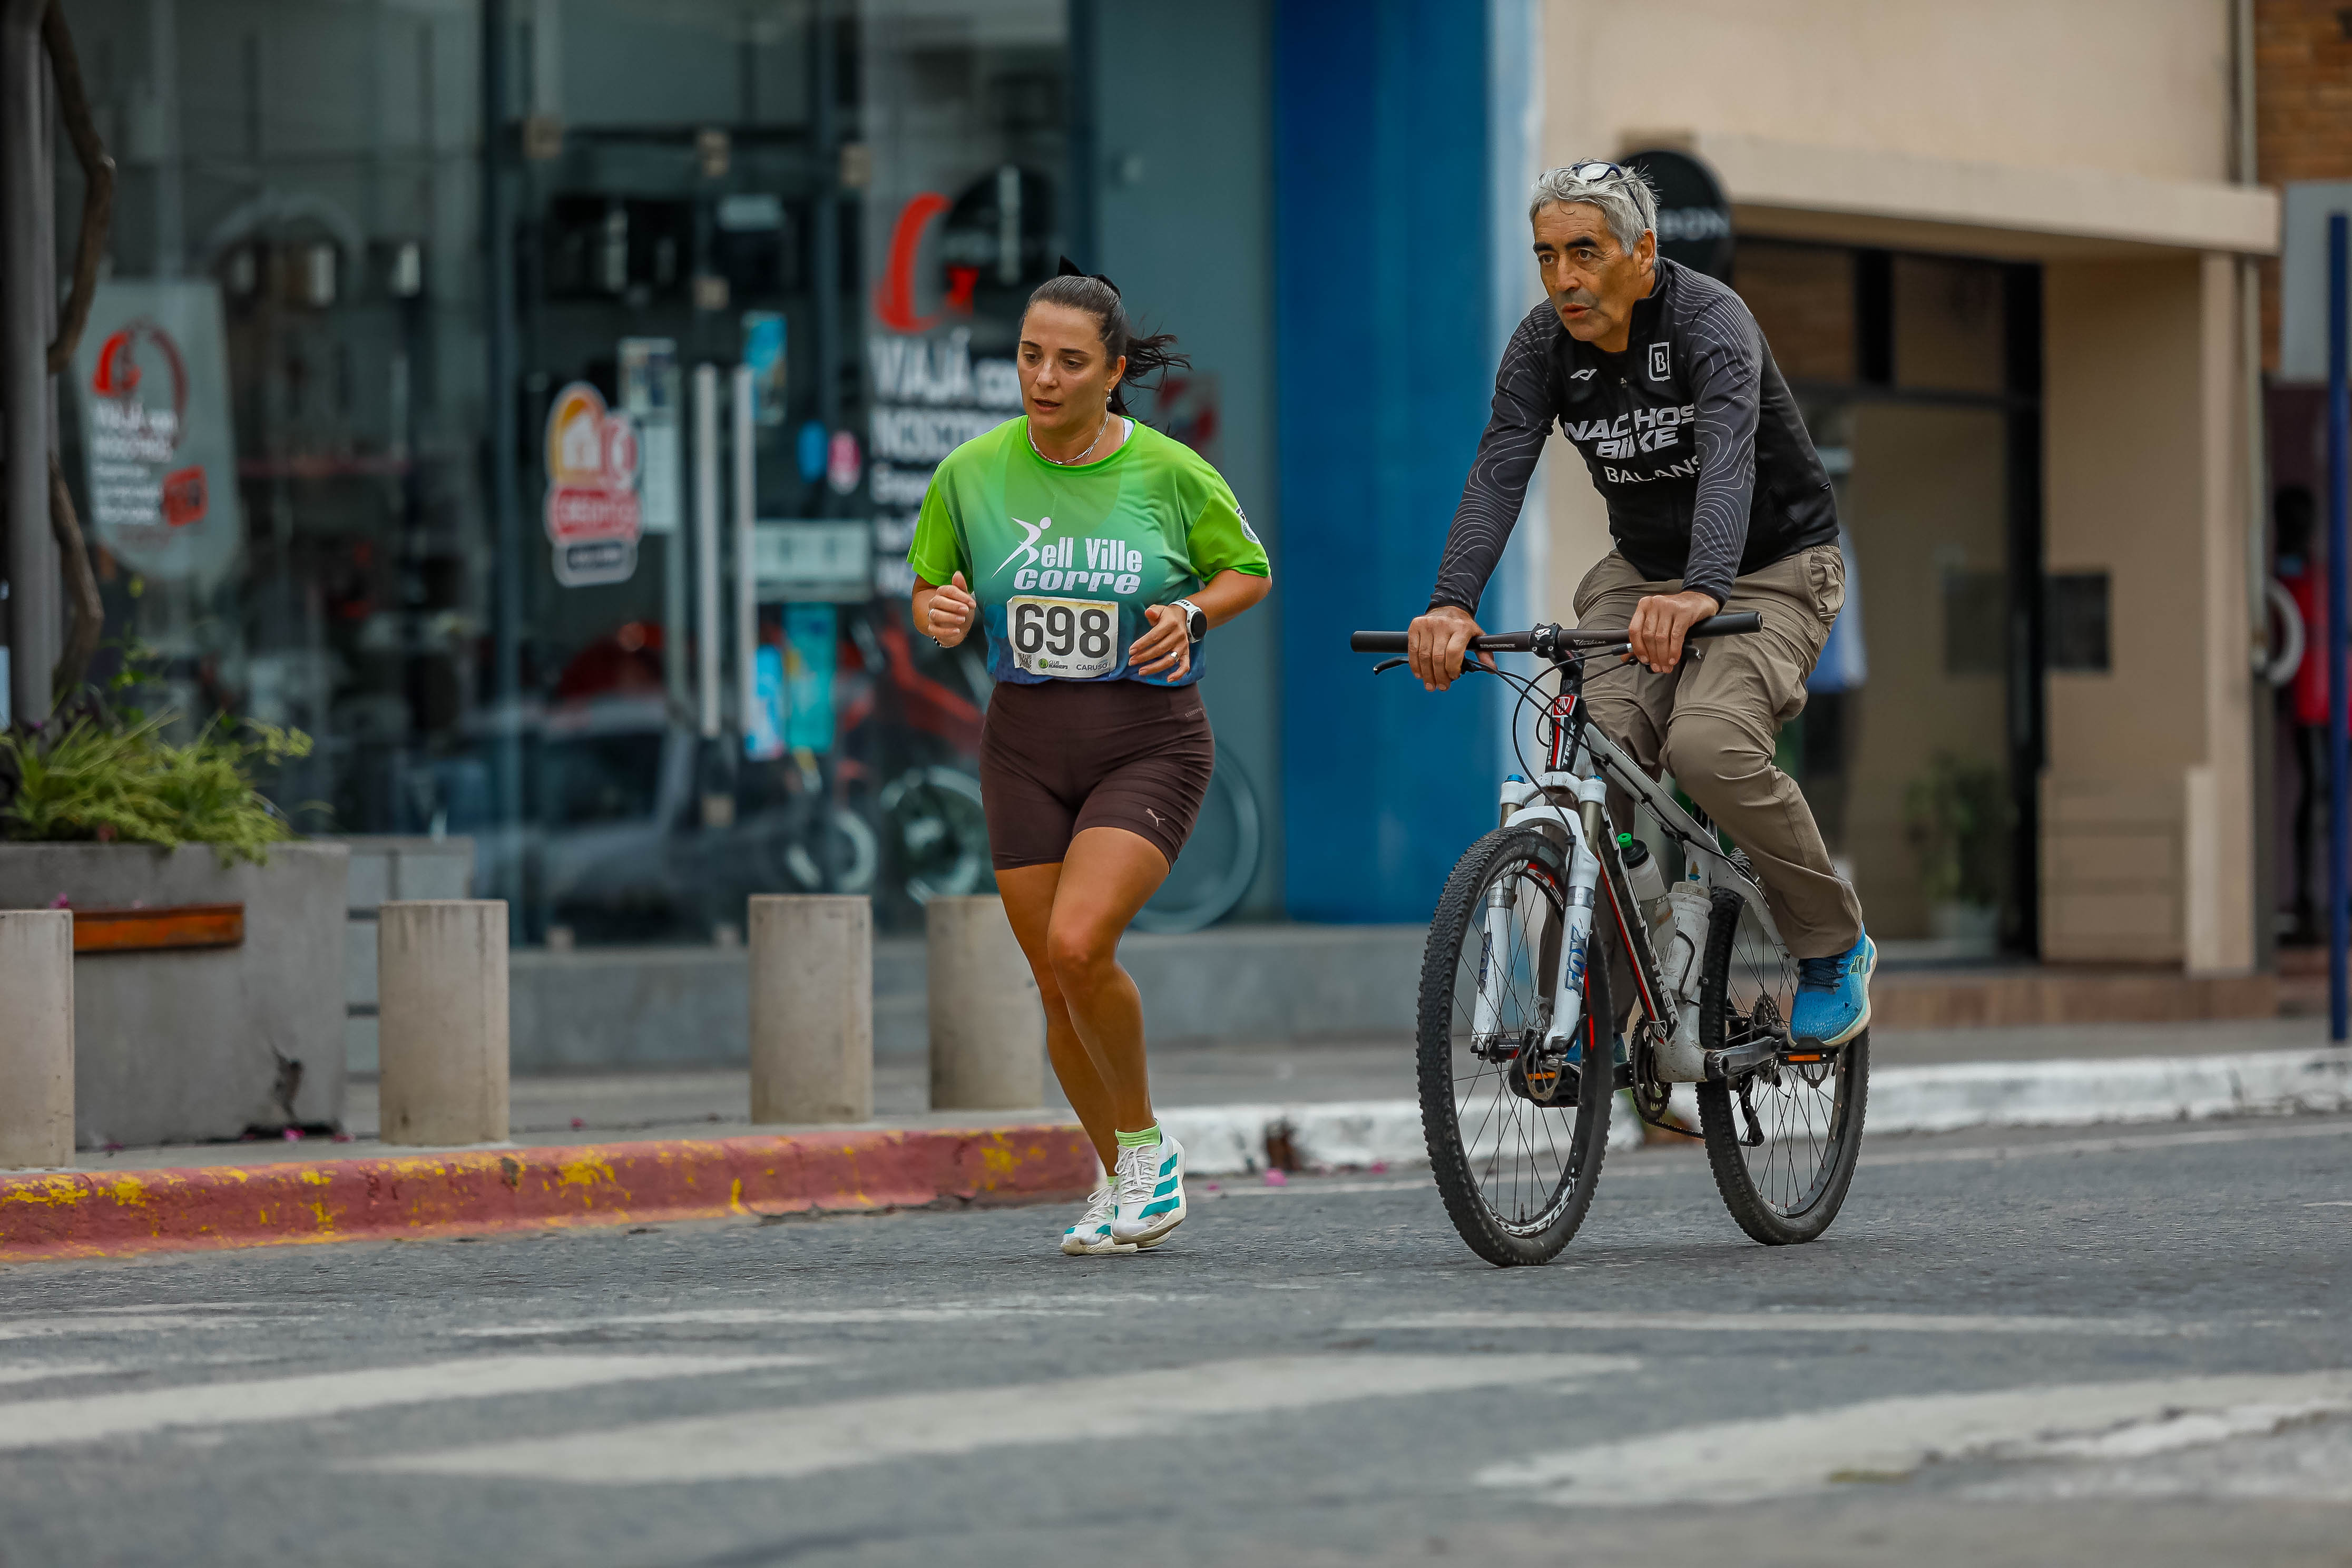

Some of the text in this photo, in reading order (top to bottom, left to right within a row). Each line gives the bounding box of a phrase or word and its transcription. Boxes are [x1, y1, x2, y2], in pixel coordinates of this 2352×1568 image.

[1564, 403, 1694, 441] NACHOS
[1596, 427, 1678, 459] BIKE
[1085, 538, 1143, 573] Ville
[1013, 569, 1141, 595] corre
[1015, 603, 1111, 659] 698
[1076, 662, 1108, 671] CARUSO
